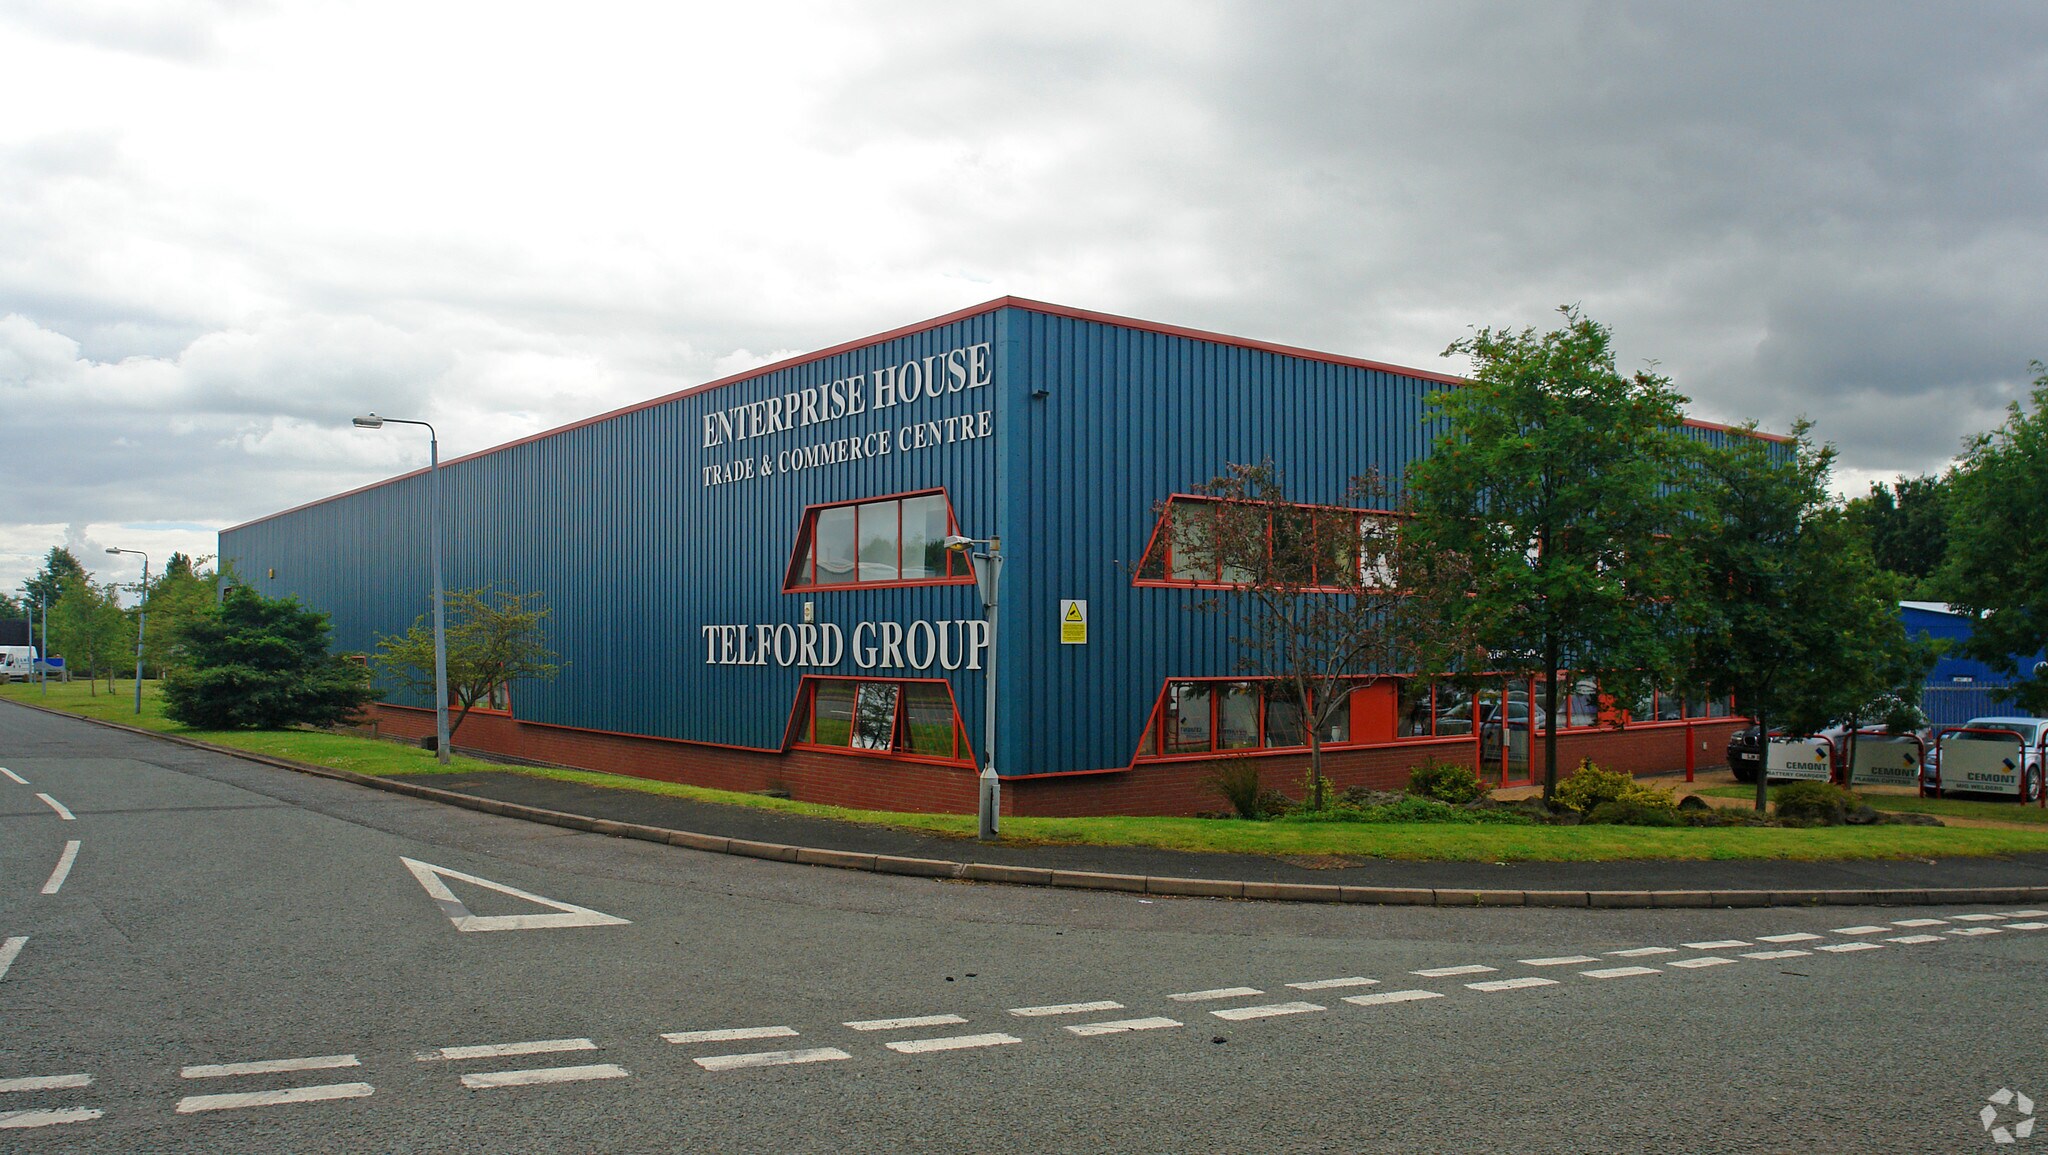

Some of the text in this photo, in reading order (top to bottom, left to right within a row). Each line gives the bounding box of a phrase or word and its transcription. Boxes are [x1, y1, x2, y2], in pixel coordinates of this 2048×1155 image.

[702, 342, 991, 449] ENTERPRISE HOUSE
[703, 410, 993, 487] TRADE & COMMERCE CENTRE
[702, 620, 989, 670] TELFORD GROUP
[1786, 761, 1828, 771] CEMONT
[1871, 766, 1916, 777] CEMONT
[1967, 772, 2016, 784] CEMONT
